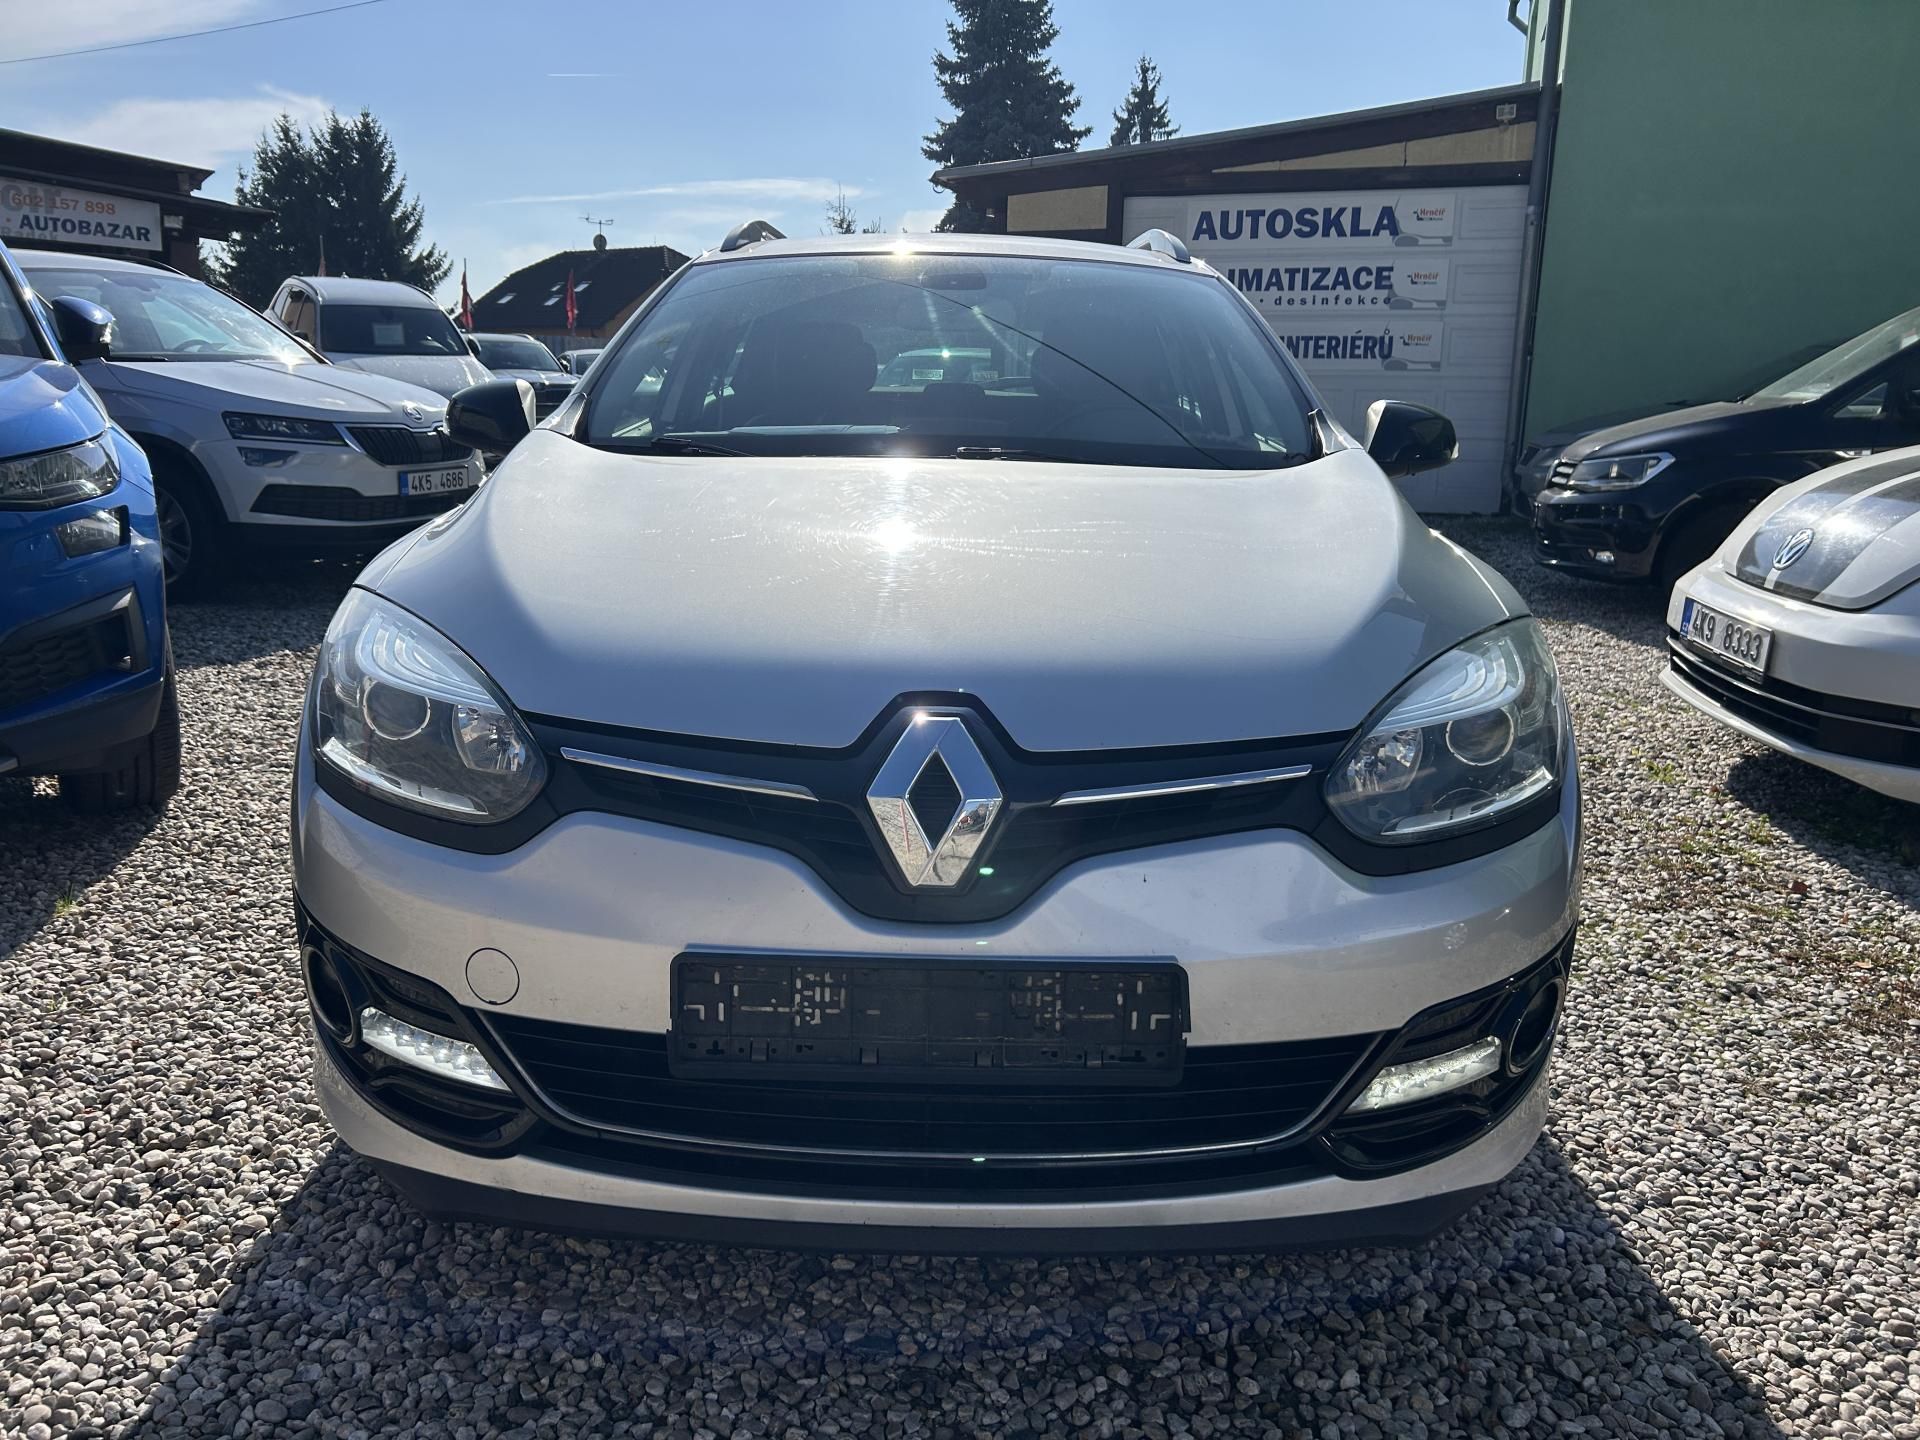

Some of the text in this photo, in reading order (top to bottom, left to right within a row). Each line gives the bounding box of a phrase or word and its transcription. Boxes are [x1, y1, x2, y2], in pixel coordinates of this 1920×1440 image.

[84, 200, 116, 215] 898
[19, 214, 150, 242] AUTOBAZAR
[1192, 206, 1399, 241] AUTOSKLA
[411, 471, 464, 492] 4K5 4686
[1693, 608, 1763, 662] 4K9 8333
